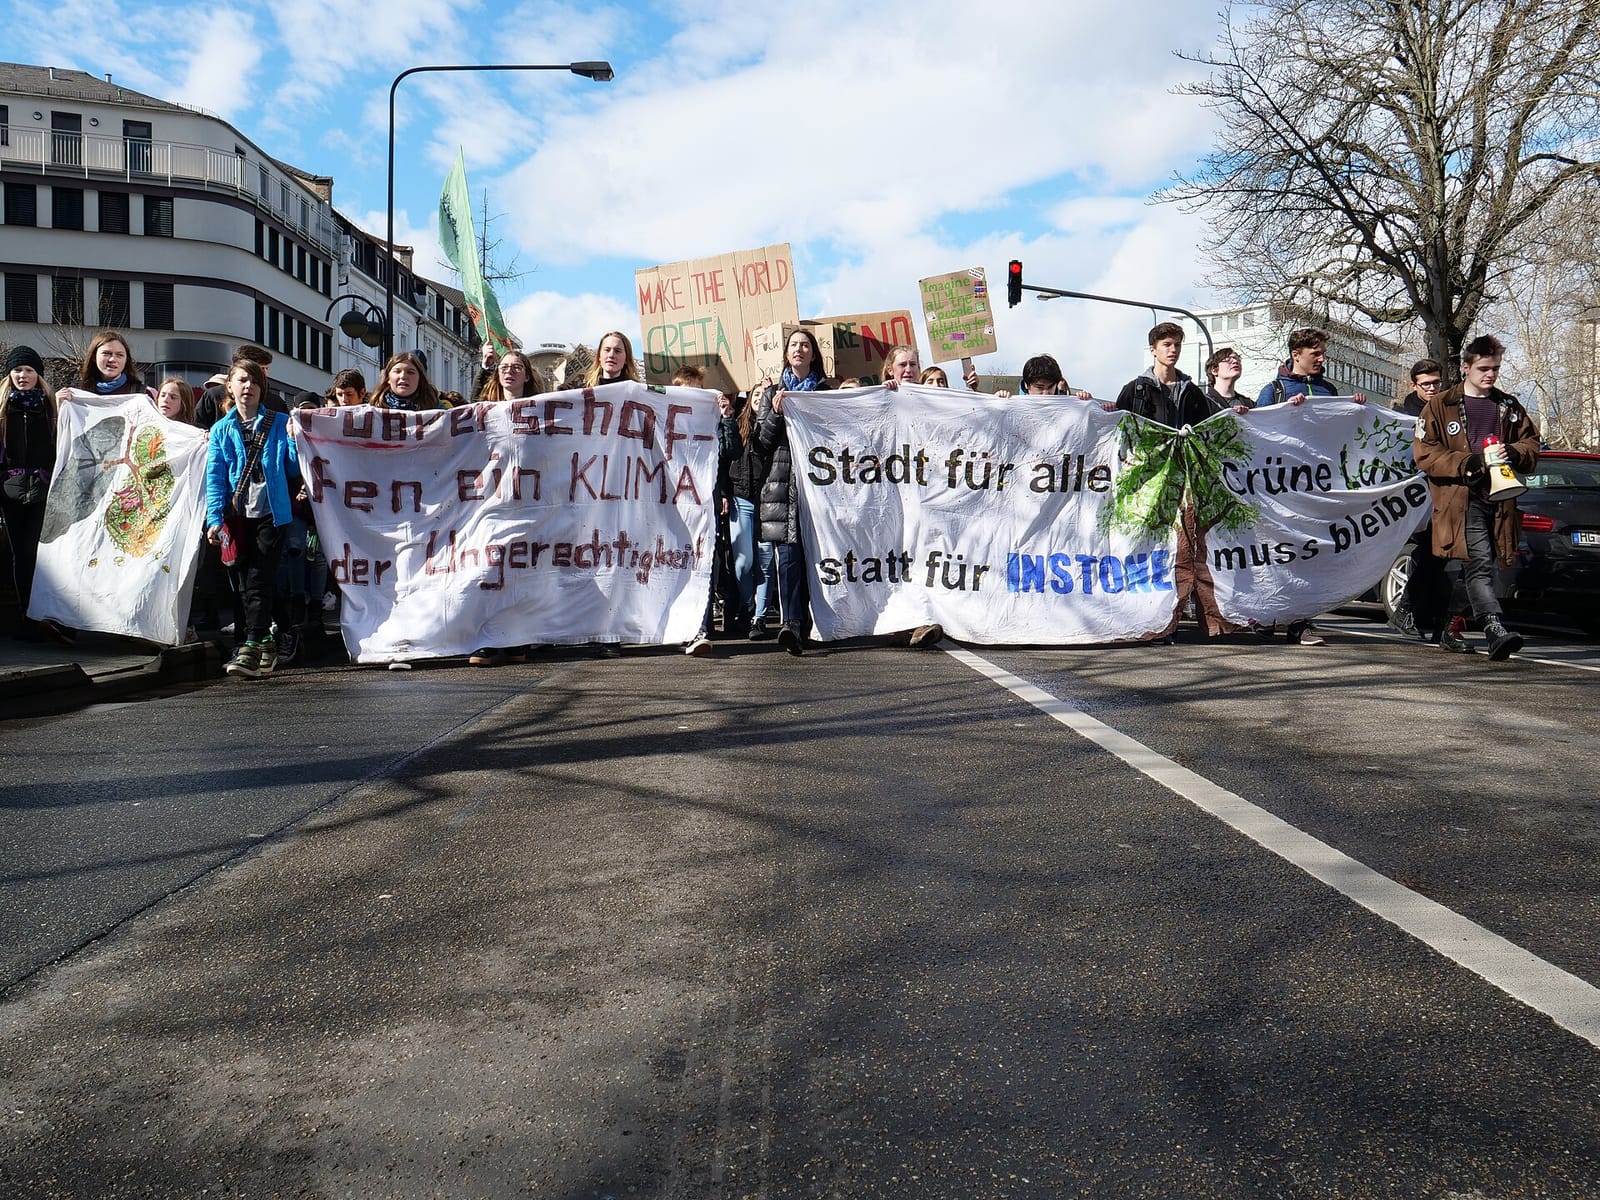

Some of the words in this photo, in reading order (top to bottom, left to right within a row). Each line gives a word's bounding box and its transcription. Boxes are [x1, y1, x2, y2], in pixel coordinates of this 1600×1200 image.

[638, 277, 685, 315] MAKE
[691, 270, 726, 305] THE
[733, 259, 789, 298] WORLD
[922, 277, 971, 297] Imagine
[926, 292, 944, 311] all
[951, 291, 972, 307] the
[647, 316, 733, 374] GRETA
[835, 322, 859, 349] RE
[861, 316, 911, 361] NO
[311, 456, 423, 513] fen
[457, 453, 541, 501] ein
[569, 452, 701, 505] KLIMA
[807, 444, 929, 487] Stadt
[945, 449, 1015, 491] für
[1029, 454, 1111, 493] alle
[1214, 539, 1320, 571] muss
[1329, 482, 1428, 553] bleibe
[330, 543, 391, 586] der
[819, 549, 913, 586] statt
[925, 550, 989, 592] für
[1006, 549, 1173, 595] INSTONE
